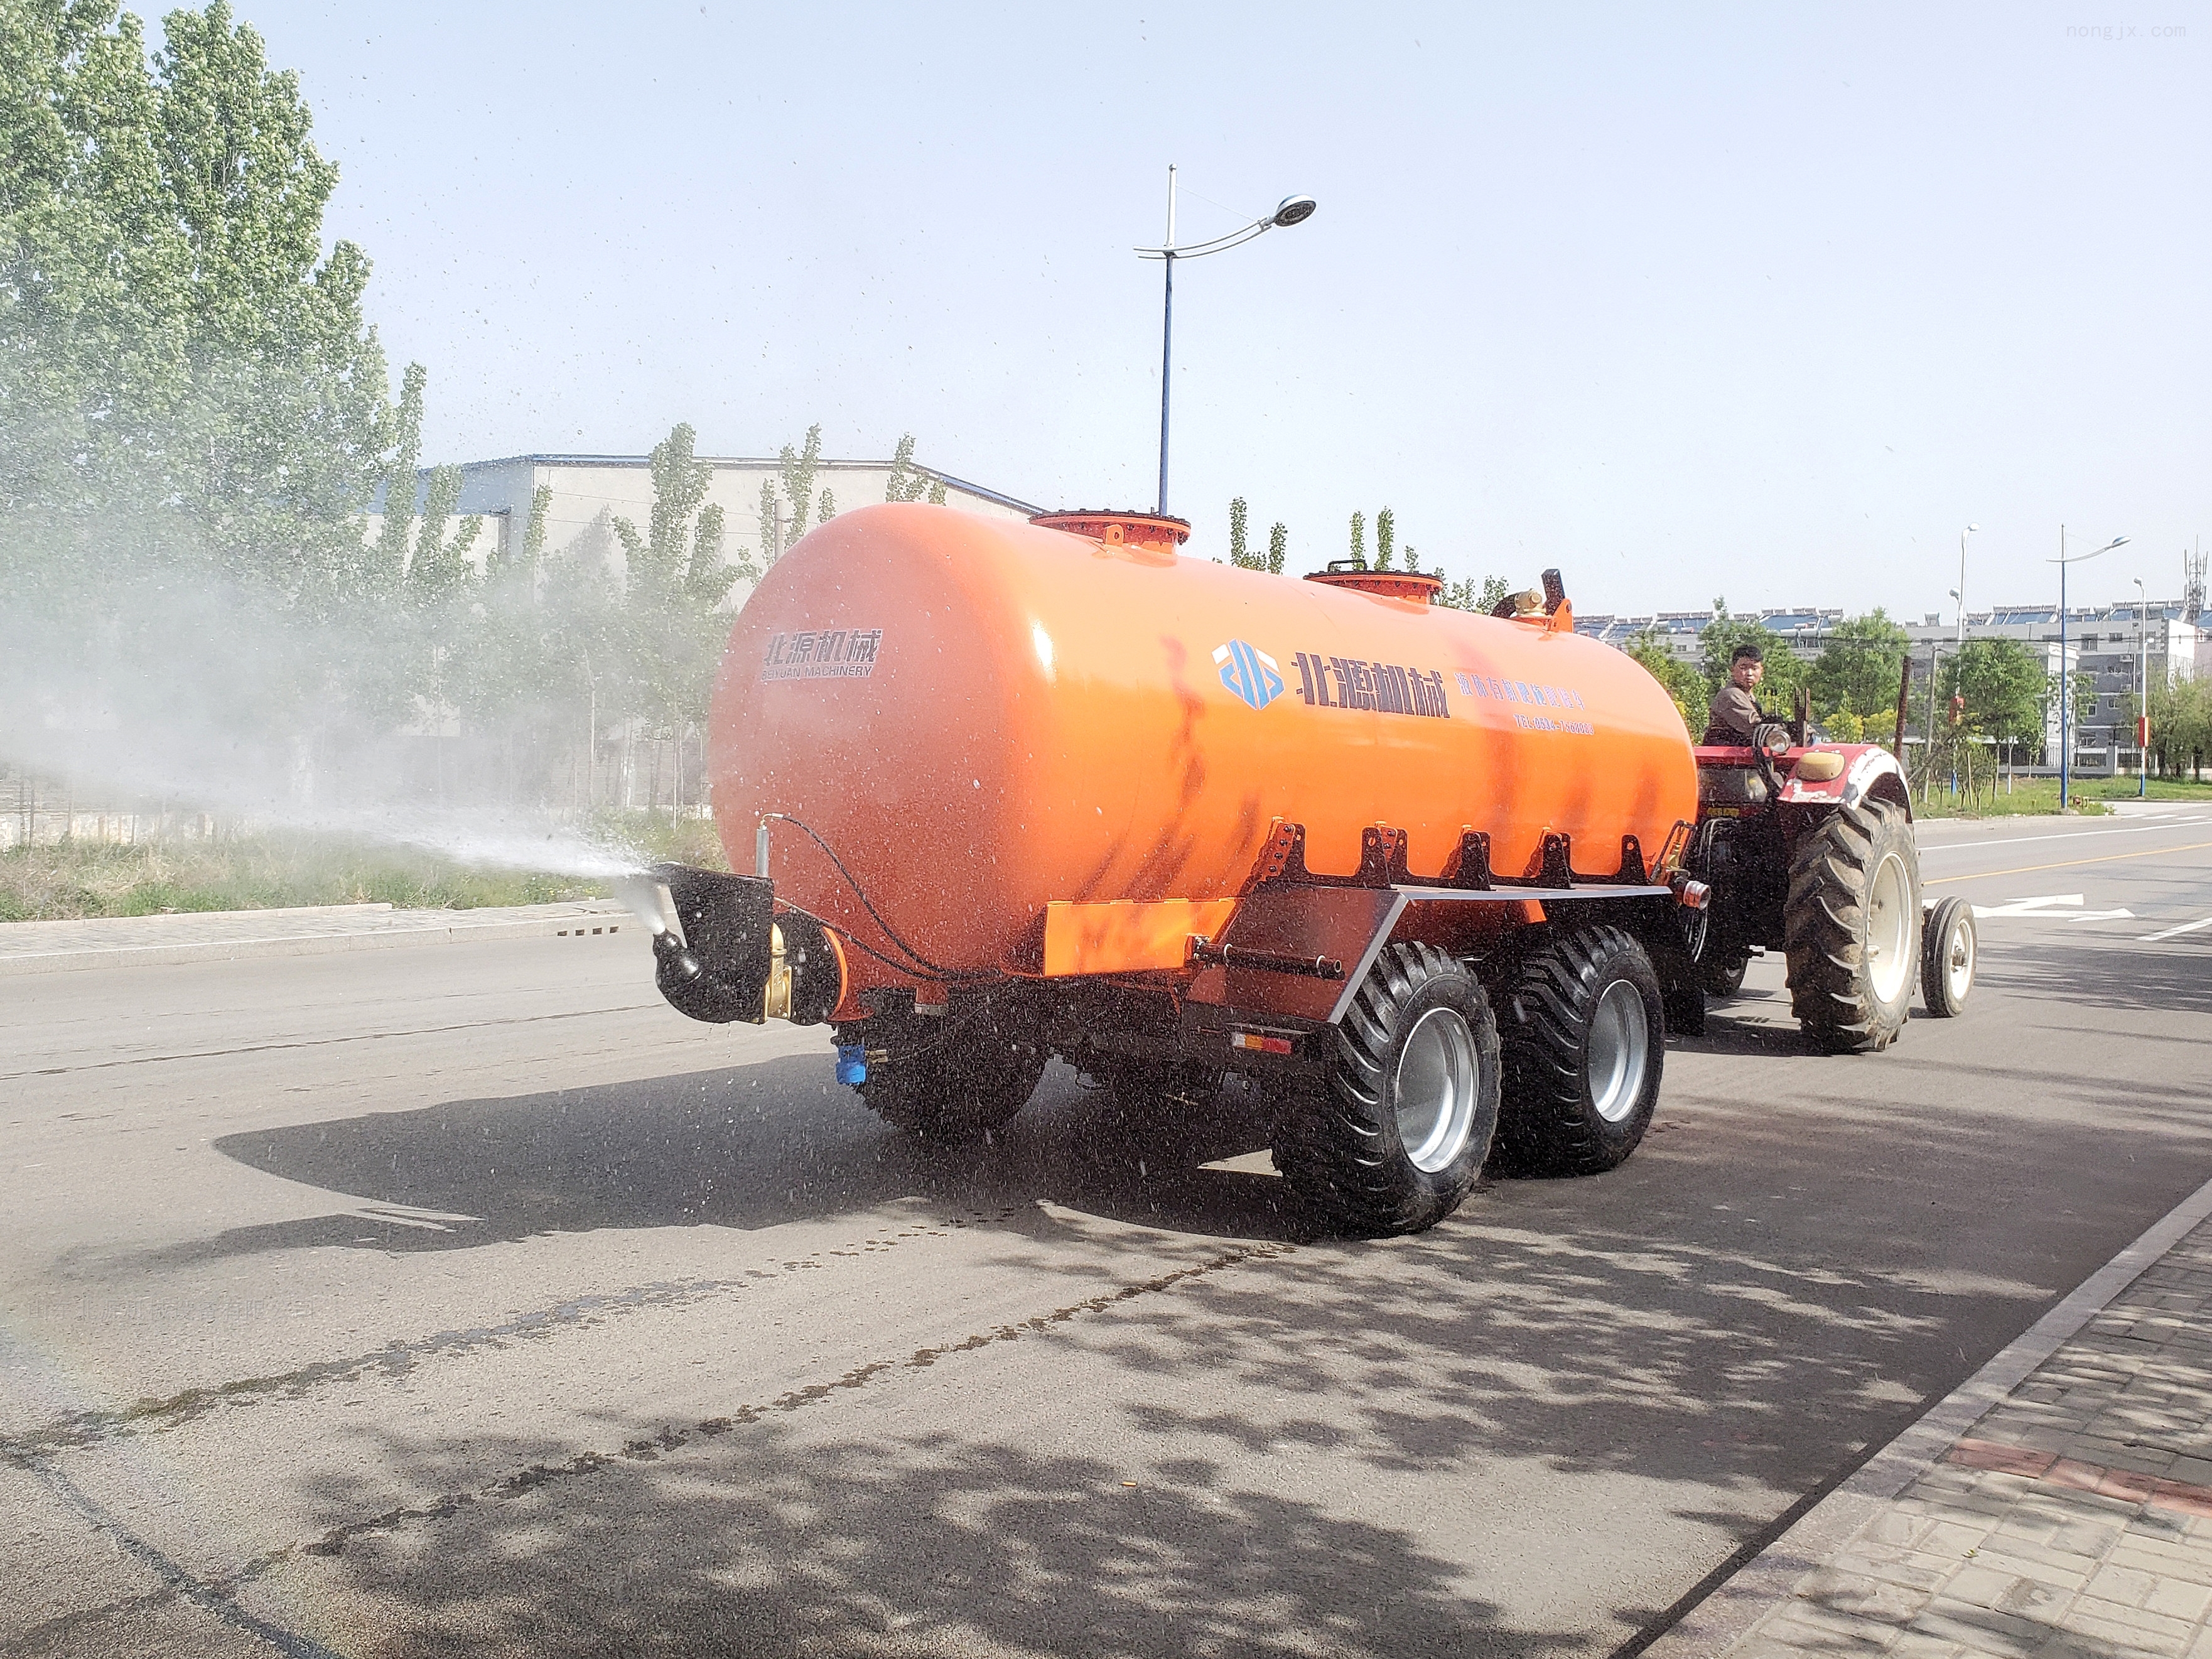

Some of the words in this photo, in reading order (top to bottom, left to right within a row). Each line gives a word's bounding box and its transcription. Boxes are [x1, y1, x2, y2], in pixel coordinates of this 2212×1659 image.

[763, 629, 882, 666] 北源机械
[761, 666, 801, 680] BEIYUAN
[805, 665, 873, 677] MACHINERY
[1290, 652, 1450, 719] 北源机械
